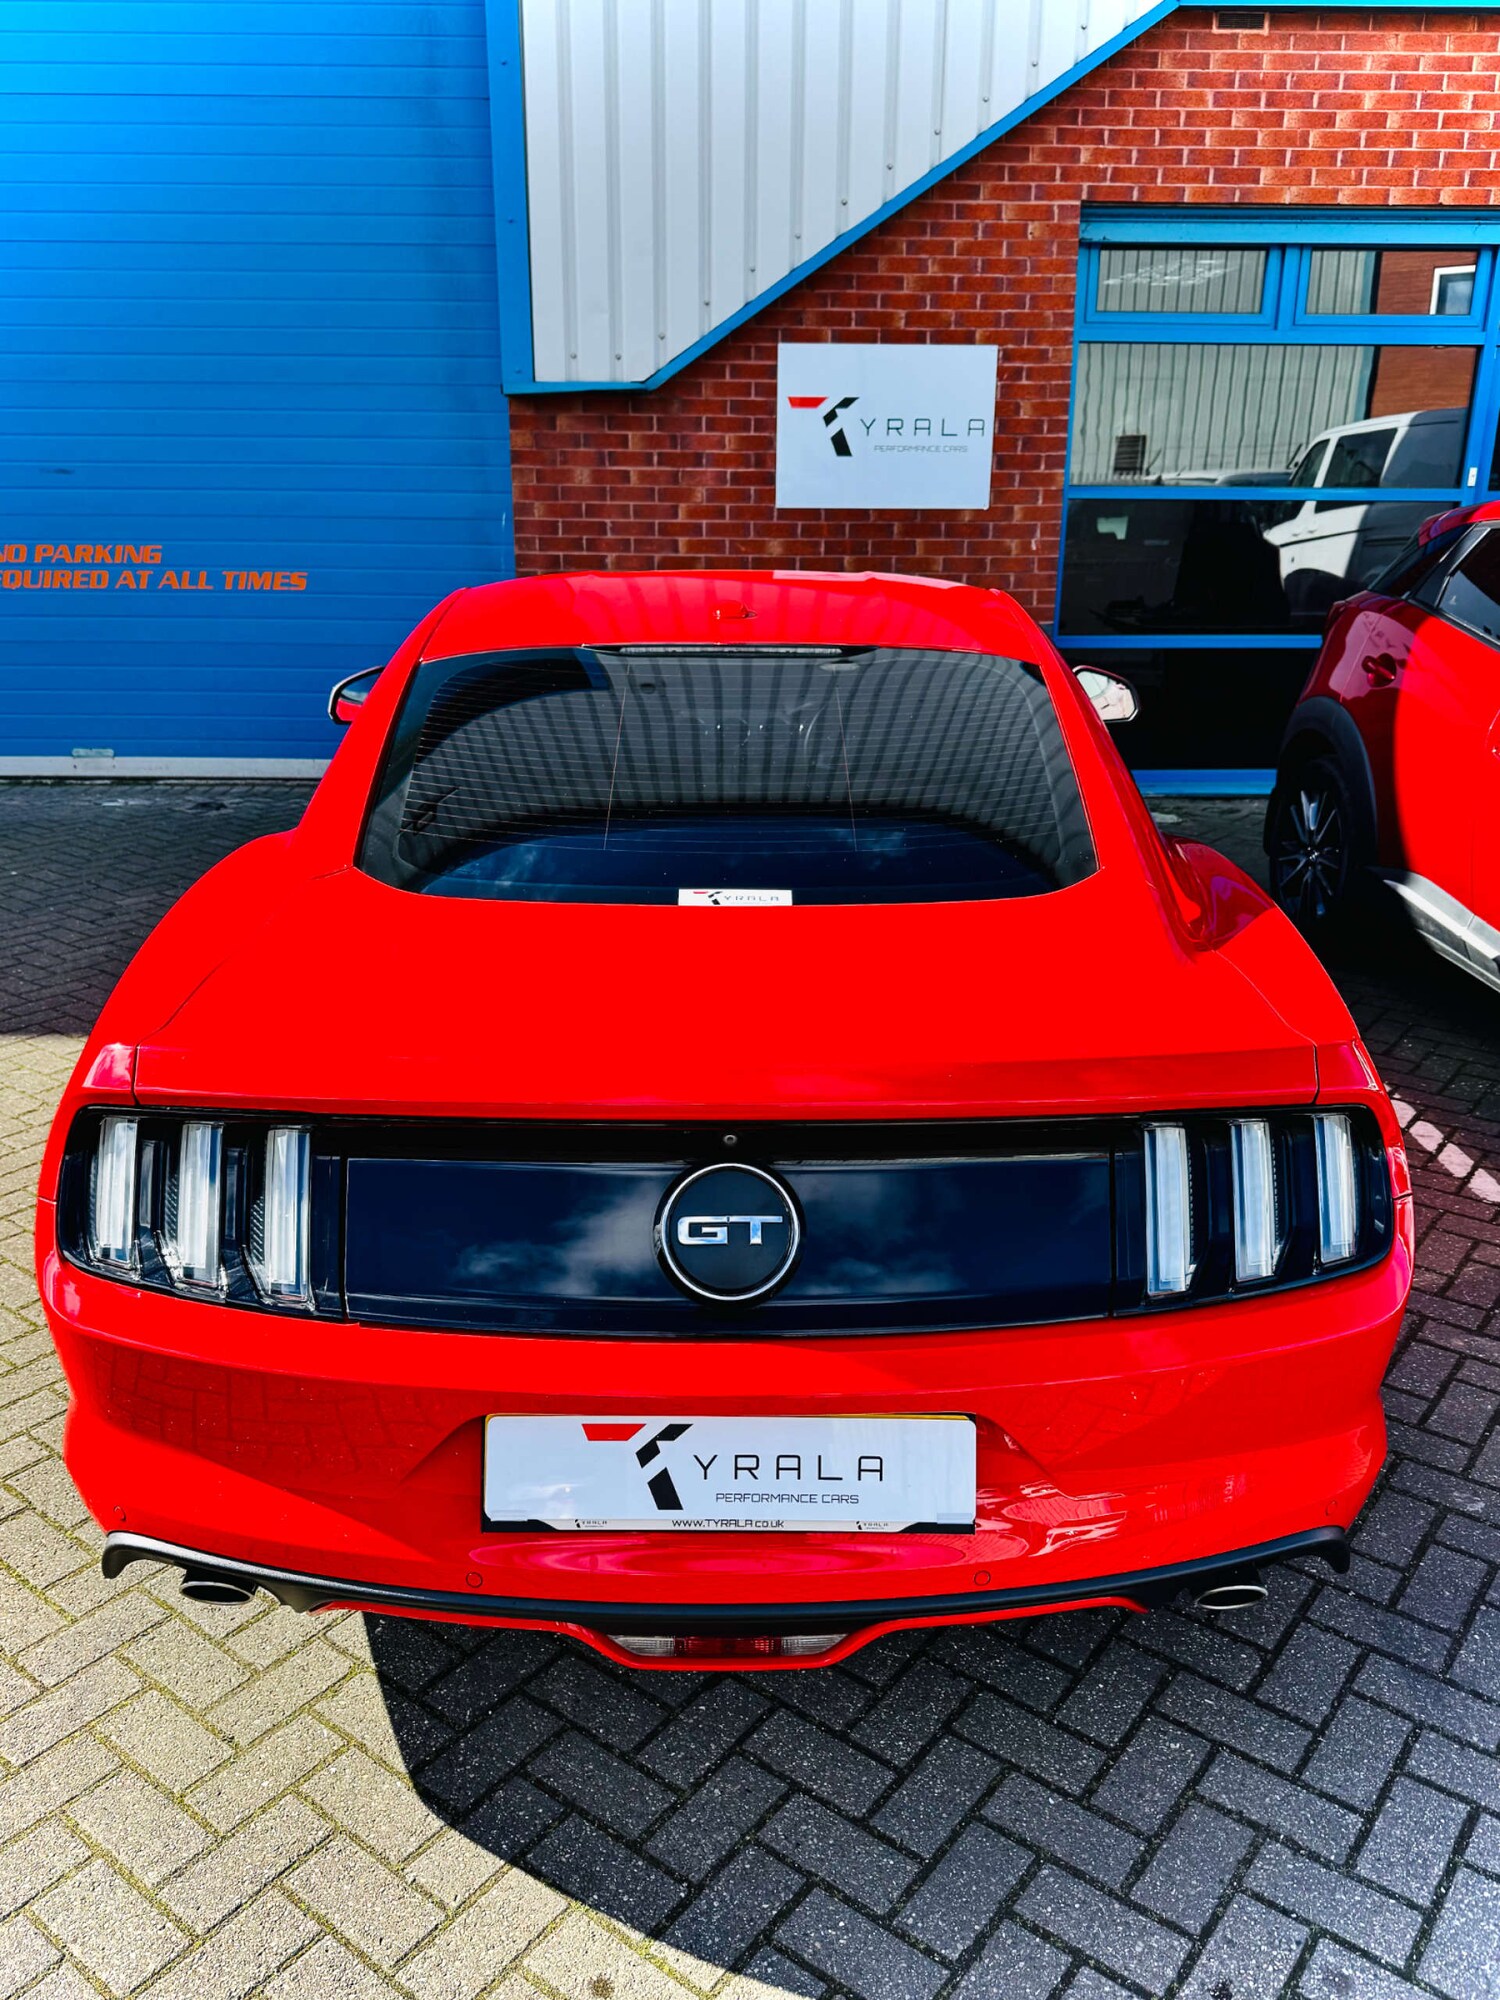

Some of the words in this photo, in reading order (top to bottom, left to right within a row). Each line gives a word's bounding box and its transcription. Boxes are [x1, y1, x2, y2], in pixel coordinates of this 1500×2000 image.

[34, 544, 163, 564] PARKING
[0, 569, 109, 590] QUIRED
[115, 571, 154, 590] AT
[158, 571, 214, 590] ALL
[222, 571, 309, 591] TIMES
[677, 1215, 784, 1245] GT
[715, 1492, 818, 1504] PERFORMANCE
[821, 1493, 860, 1504] CARS
